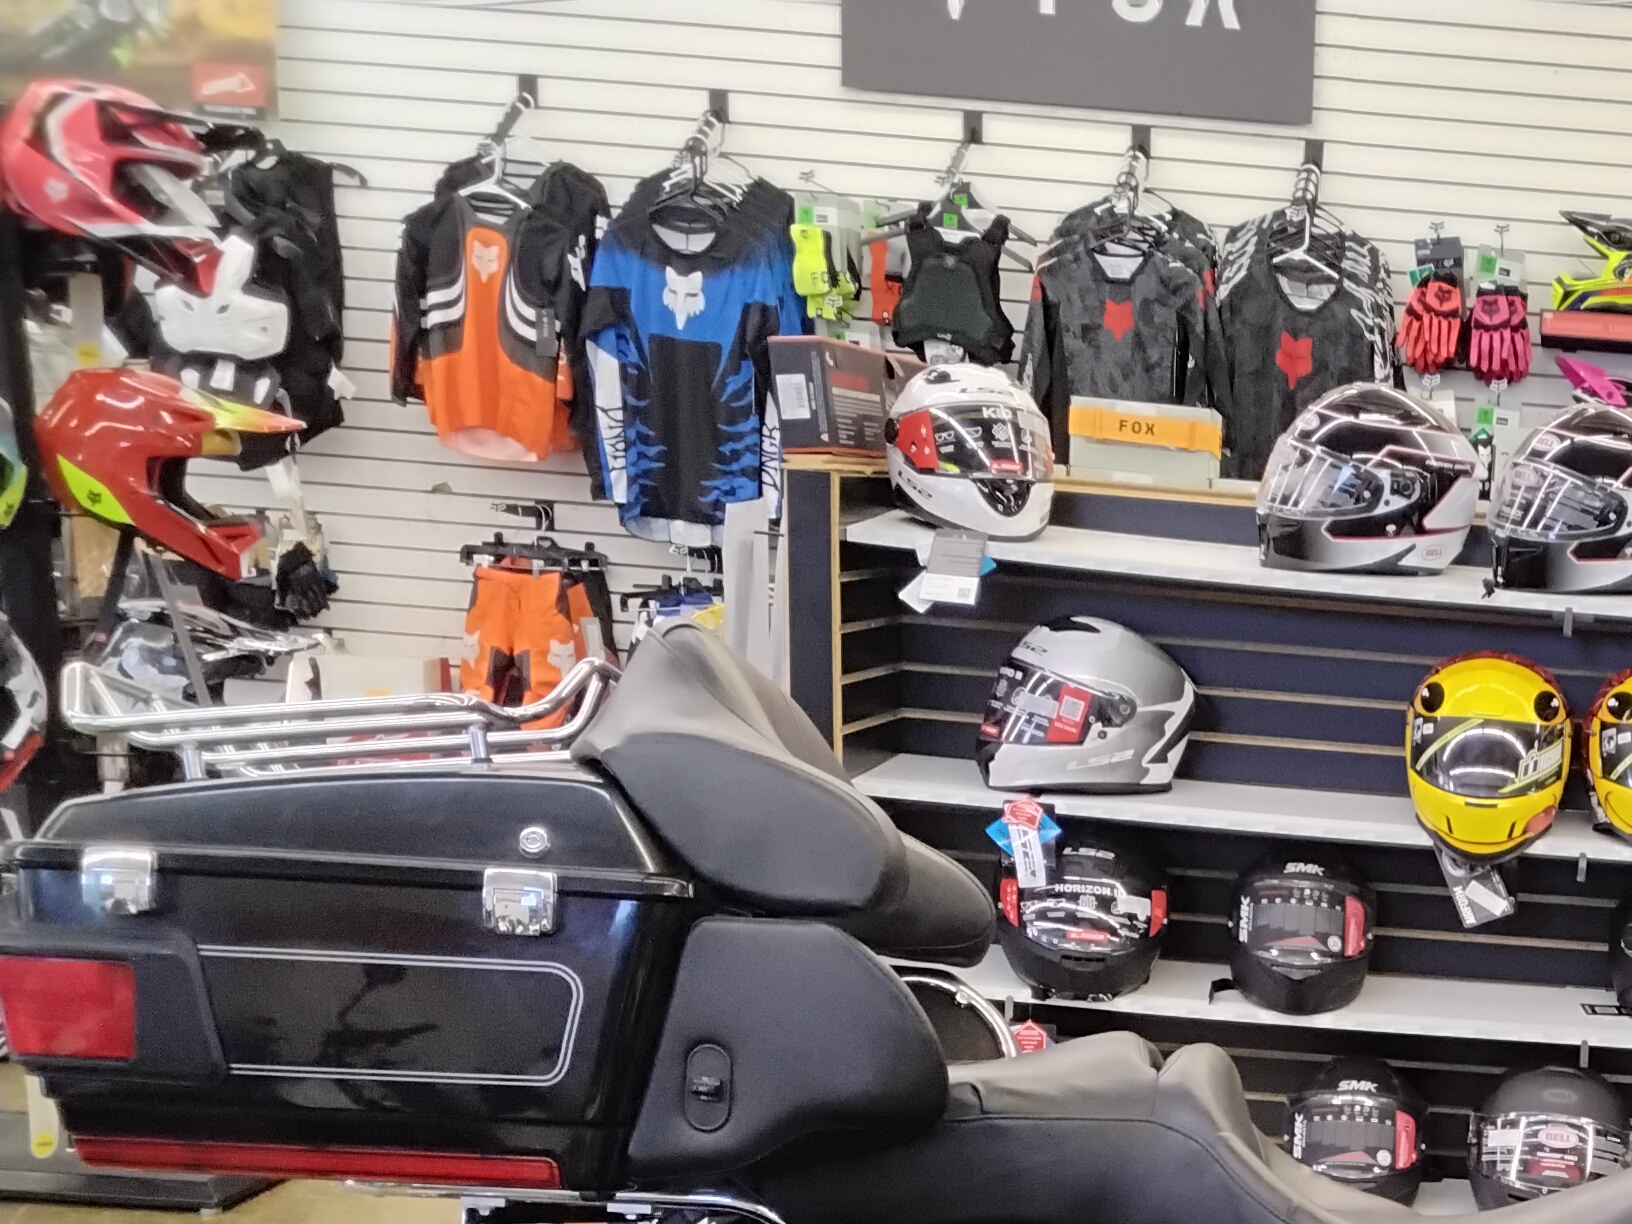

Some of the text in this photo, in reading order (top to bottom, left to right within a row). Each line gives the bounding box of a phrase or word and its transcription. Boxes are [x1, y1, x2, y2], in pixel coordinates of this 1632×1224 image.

[1118, 419, 1155, 436] FOX
[1424, 548, 1444, 558] BELL
[1067, 749, 1135, 771] LS2
[1283, 862, 1326, 876] SMK
[1054, 884, 1111, 896] HORIZON
[1453, 885, 1478, 926] AIRFORM
[1239, 894, 1250, 944] SMK
[1336, 1080, 1379, 1093] SMK
[1292, 1112, 1304, 1160] SMK
[1545, 1131, 1572, 1144] BELL
